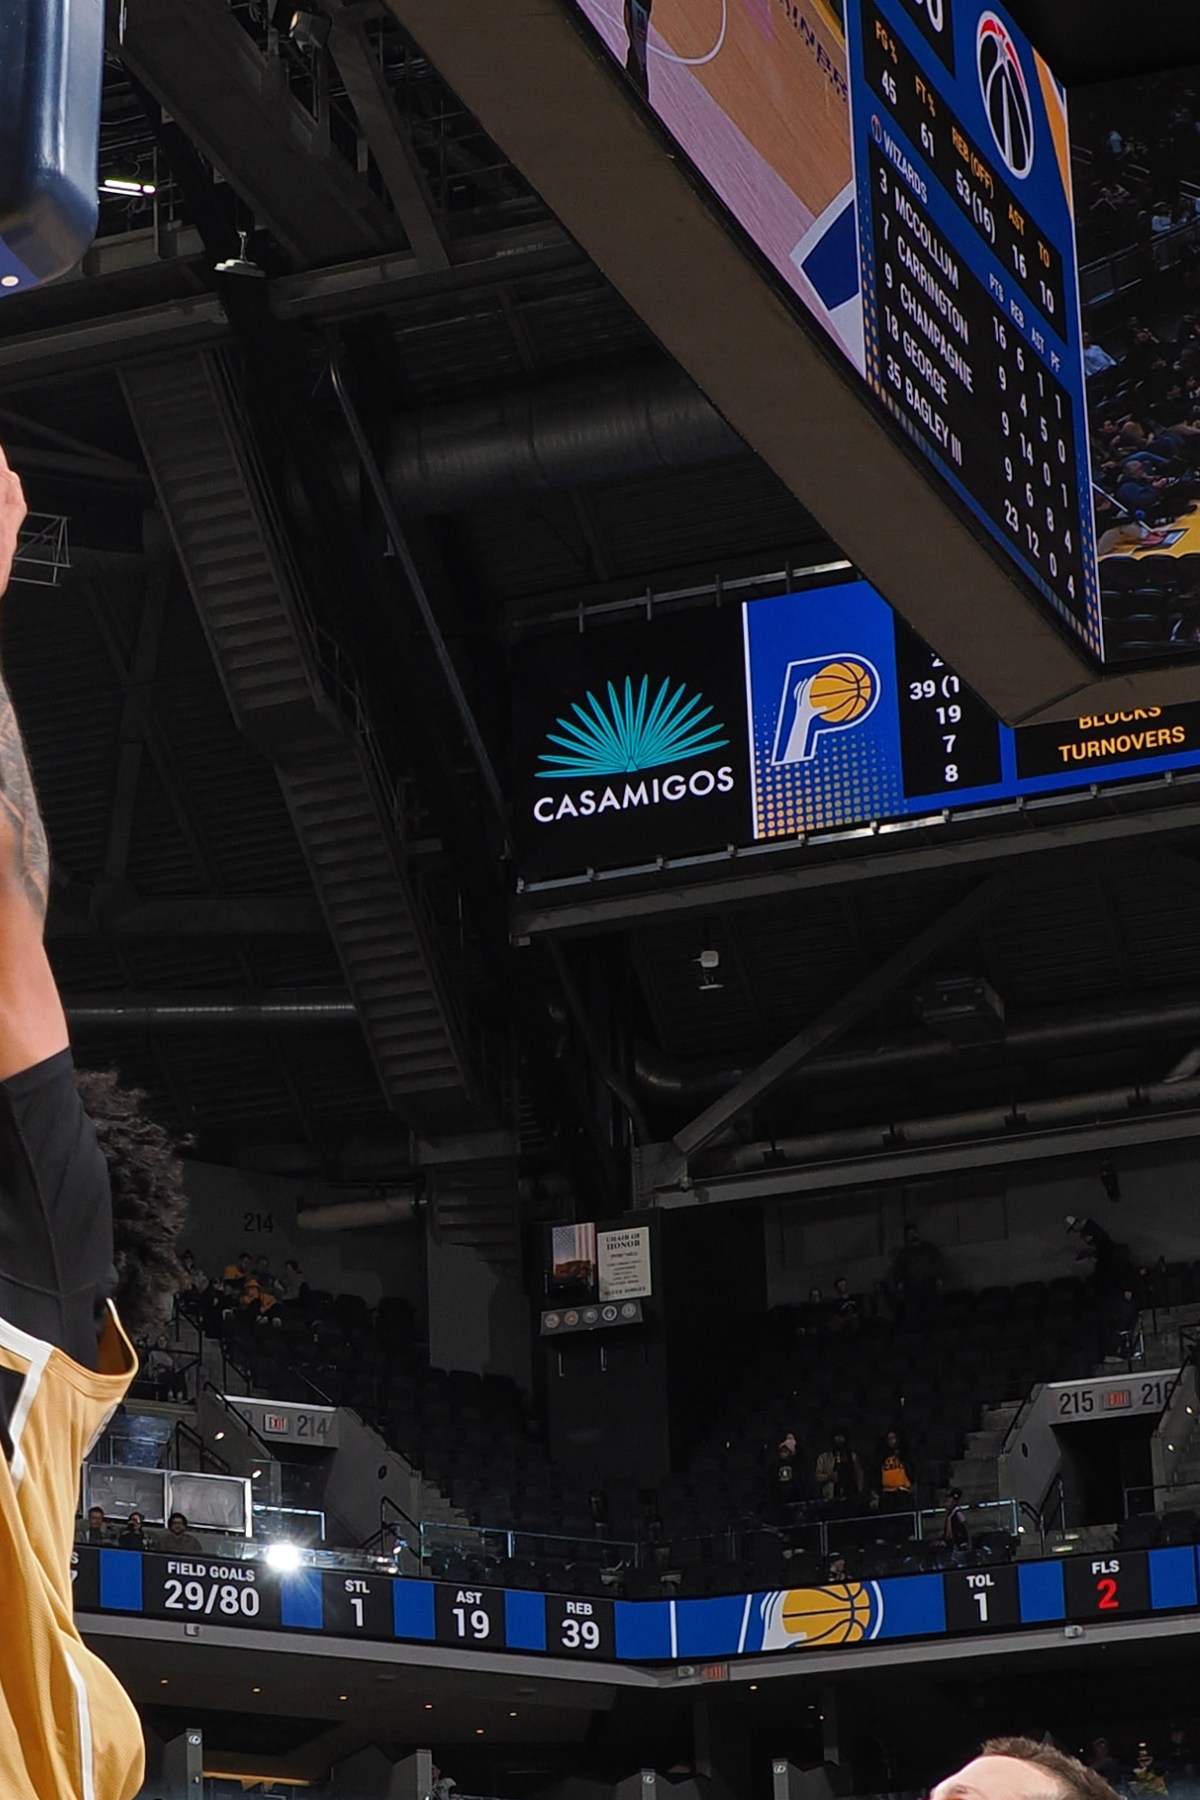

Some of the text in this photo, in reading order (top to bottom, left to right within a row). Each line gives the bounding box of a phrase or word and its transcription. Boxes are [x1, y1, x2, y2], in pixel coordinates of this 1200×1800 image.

[875, 20, 889, 51] FG
[881, 70, 897, 105] 45
[915, 75, 927, 104] FT
[920, 122, 934, 158] 61
[951, 126, 994, 199] REB (OFF)
[955, 168, 996, 244] 53 (16)
[1008, 203, 1025, 236] AST
[883, 130, 928, 204] WIZARDS
[989, 272, 1004, 303] PTS
[1010, 299, 1025, 329] REB
[1031, 326, 1045, 354] AST
[1037, 239, 1050, 268] TO
[1012, 244, 1027, 279] 16
[880, 167, 1062, 419] 3 MCCOLLUM 16 6 1 1
[1039, 280, 1055, 314] 10
[881, 212, 1066, 464] 7 CARRINGTON 9 4 5 0
[884, 262, 1068, 508] 9 CHAMPAGNIE 9 14 0 1
[885, 305, 1072, 554] 18 GEORGE 9 6 8 4
[887, 353, 1075, 599] 35 BAGLEY III 23 12 0 4
[909, 679, 936, 701] 39
[936, 704, 962, 725] 19
[942, 733, 956, 753] 7
[1057, 725, 1186, 762] TURNOVERS
[944, 763, 958, 782] 8
[533, 766, 734, 822] CASAMIGOS
[243, 1213, 273, 1233] 214
[1060, 1392, 1094, 1415] 215
[297, 1414, 328, 1438] 214
[167, 1561, 255, 1582] FIELD GOALS
[966, 1574, 995, 1589] TOL
[1091, 1560, 1120, 1576] FLS
[163, 1579, 260, 1617] 29/80
[344, 1579, 370, 1594] STL
[455, 1590, 482, 1605] AST
[1096, 1577, 1120, 1610] 2
[350, 1598, 365, 1627] 1
[565, 1601, 593, 1616] REB
[973, 1592, 988, 1622] 1
[452, 1608, 490, 1639] 19
[561, 1619, 600, 1650] 39
